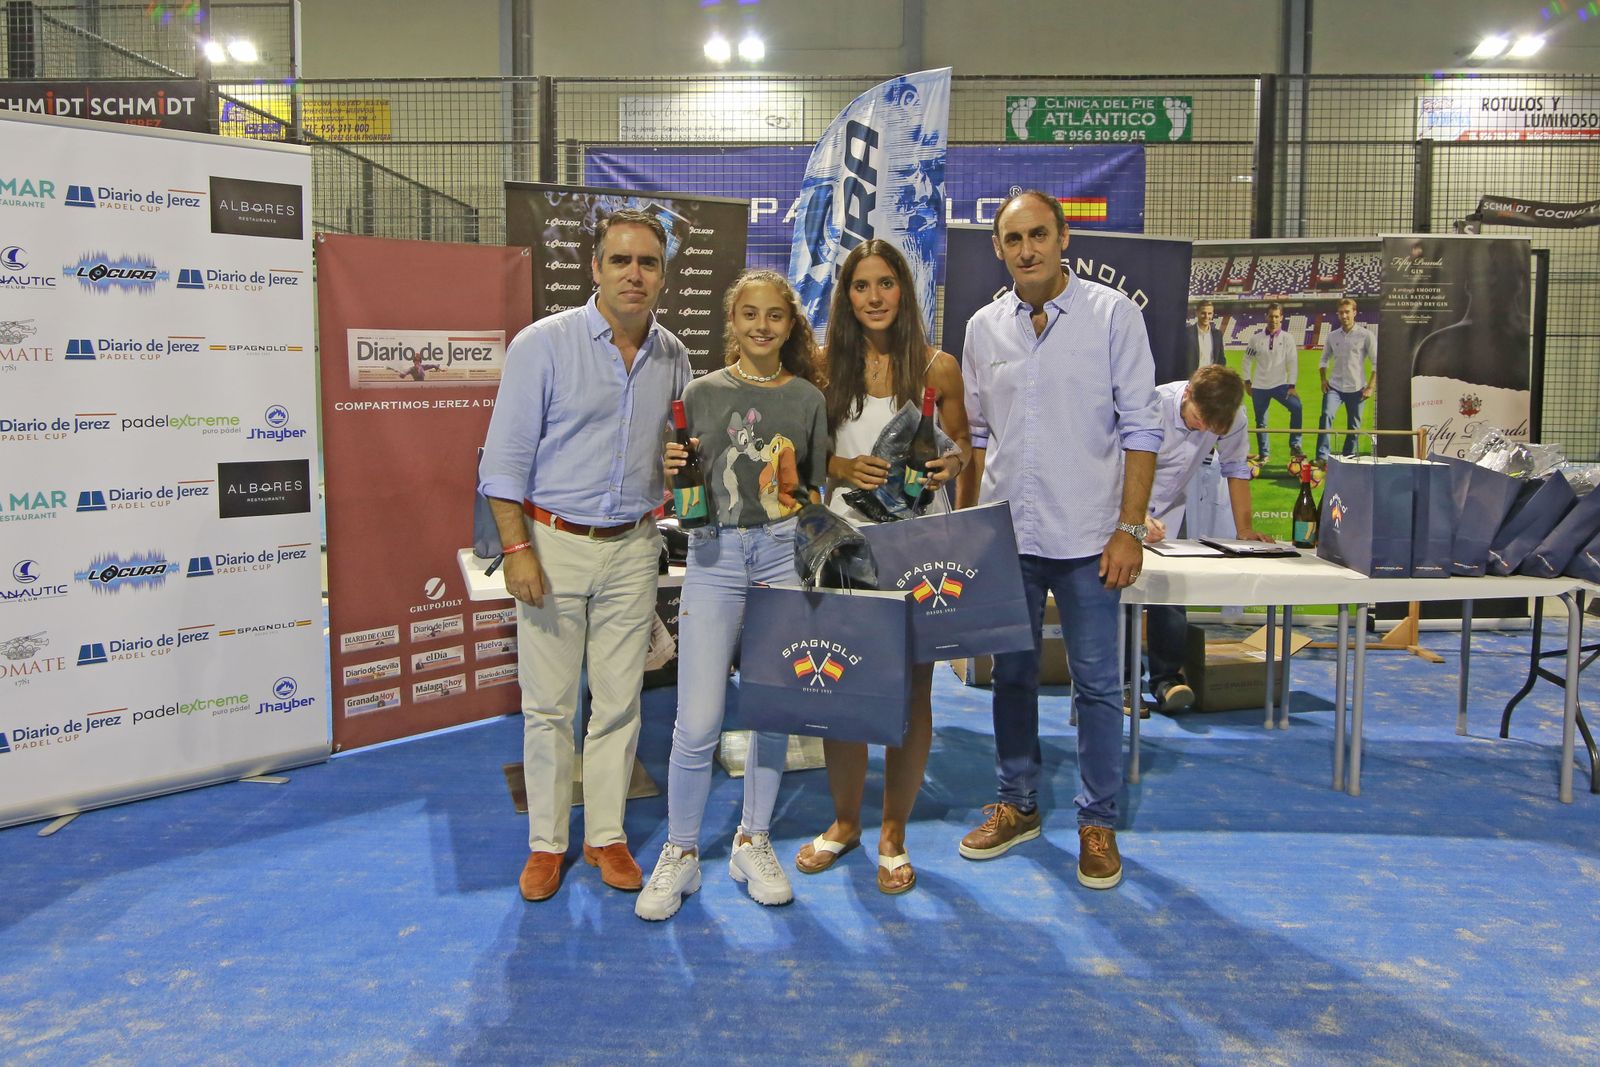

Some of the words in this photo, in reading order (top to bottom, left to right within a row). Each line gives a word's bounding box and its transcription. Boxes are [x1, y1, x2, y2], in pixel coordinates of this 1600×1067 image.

[1103, 99, 1128, 109] DEL
[1132, 98, 1154, 109] PIE
[1481, 97, 1543, 111] ROTULOS
[1552, 96, 1561, 111] Y
[1043, 109, 1156, 126] ATLÁNTICO
[1069, 130, 1092, 141] 956
[1095, 130, 1110, 141] 30
[98, 187, 143, 202] Diario
[146, 190, 164, 204] de
[167, 193, 200, 208] Jerez
[100, 202, 135, 211] PADEL
[140, 205, 161, 213] CUP
[219, 199, 295, 216] ALBORES
[545, 218, 581, 227] LOCURA
[545, 239, 581, 248] LOCURA
[545, 261, 581, 270] LOCURA
[680, 267, 713, 276] LOCURA
[77, 264, 158, 282] LOCURA
[206, 269, 247, 283] Diario
[250, 271, 266, 284] de
[268, 273, 298, 287] Jerez
[545, 282, 581, 291] LOCURA
[679, 287, 712, 296] LOCURA
[678, 307, 711, 316] LOCURA
[678, 328, 710, 337] LOCURA
[98, 339, 144, 351] Diario
[146, 339, 164, 351] de
[167, 340, 200, 355] Jerez
[228, 344, 288, 352] SPAGNOLO
[356, 341, 416, 361] Diario
[420, 342, 444, 361] de
[447, 342, 492, 366] Jerez
[335, 401, 430, 411] COMPARTIMOS
[432, 400, 470, 409] JEREZ
[472, 400, 480, 408] A
[483, 399, 495, 408] DI
[0, 418, 48, 432] Diario
[51, 417, 71, 431] de
[74, 418, 111, 433] Jerez
[121, 414, 240, 432] padelextreme
[109, 488, 153, 501] Diario
[156, 486, 174, 499] de
[177, 486, 209, 500] Jerez
[227, 480, 303, 494] ALBORES
[9, 490, 68, 512] MAR
[111, 502, 145, 510] PADEL
[150, 500, 171, 508] CUP
[215, 552, 255, 566] Diario
[258, 550, 274, 562] de
[277, 549, 306, 563] Jerez
[88, 564, 167, 583] LOCURA
[217, 566, 248, 575] PADEL
[252, 563, 272, 571] CUP
[896, 560, 976, 588] SPAGNOLO
[237, 621, 296, 635] SPAGNOLO
[413, 624, 435, 634] Diario
[435, 622, 442, 630] de
[443, 620, 459, 631] Jerez
[110, 637, 153, 652] Diario
[157, 633, 174, 647] de
[177, 631, 209, 648] Jerez
[345, 634, 368, 644] DIARIO
[368, 632, 377, 640] DE
[477, 640, 503, 651] Huelva
[782, 639, 860, 666] SPAGNOLO
[111, 652, 146, 661] PADEL
[150, 648, 172, 656] CUP
[345, 668, 367, 678] Diario
[367, 666, 376, 674] de
[377, 661, 400, 672] Sevilla
[133, 694, 249, 725] padelextreme
[13, 724, 60, 742] Diario
[63, 719, 82, 734] de
[86, 716, 122, 733] Jerez
[14, 739, 52, 751] PADEL
[57, 734, 80, 744] CUP
